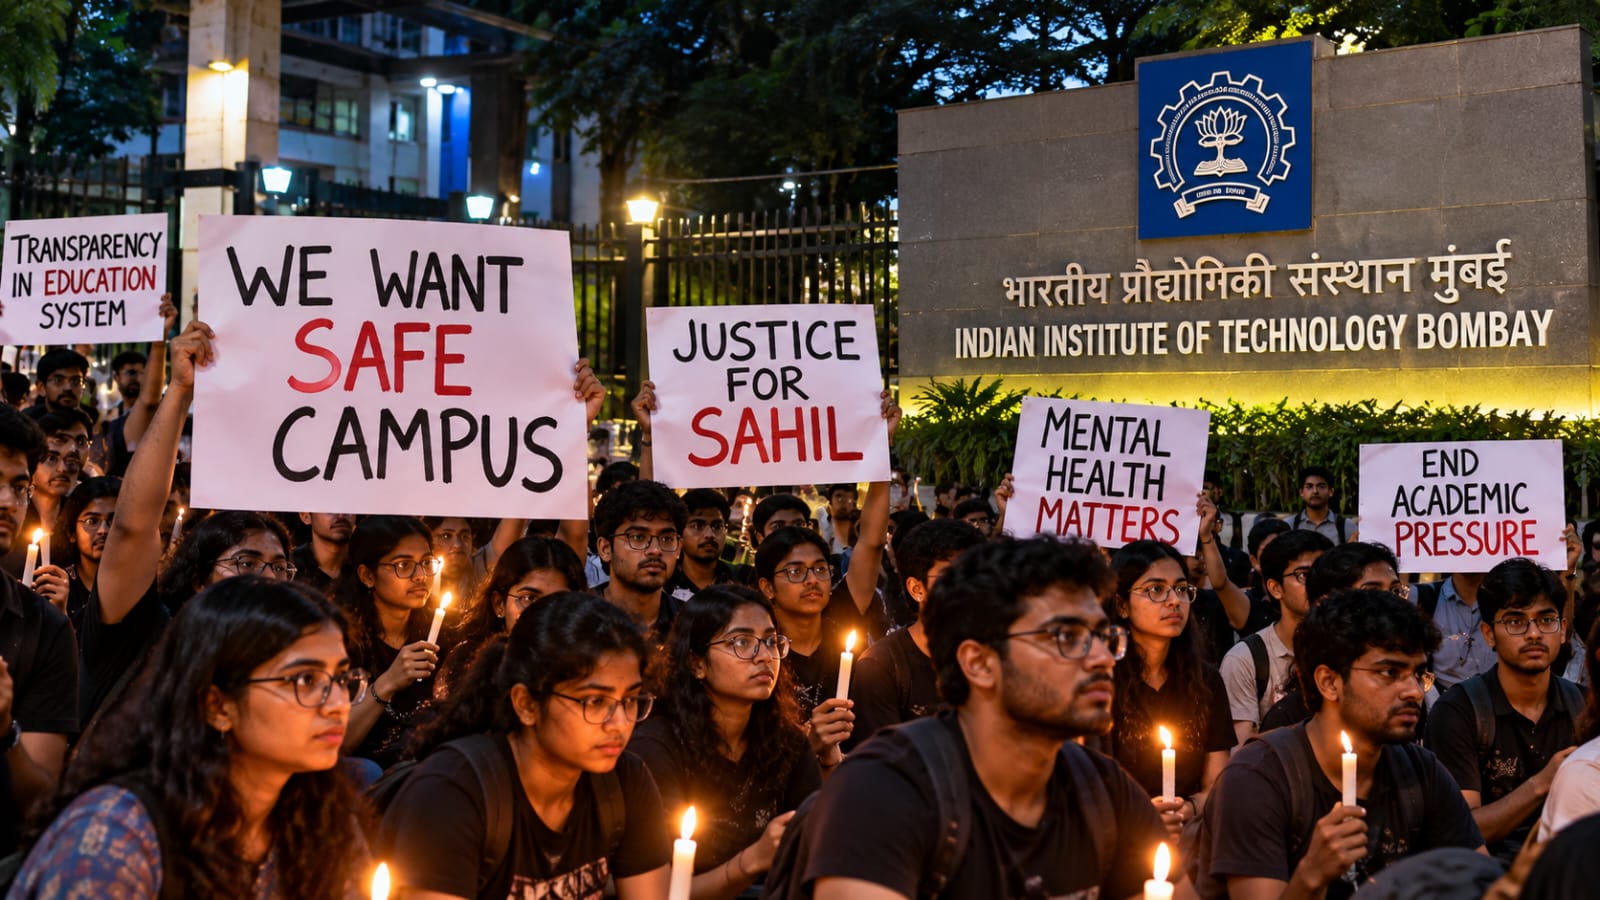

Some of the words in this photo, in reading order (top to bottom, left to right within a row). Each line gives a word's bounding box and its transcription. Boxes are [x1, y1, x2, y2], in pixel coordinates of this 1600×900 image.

[10, 231, 163, 264] TRANSPARENCY
[12, 271, 32, 298] IN
[44, 265, 157, 296] EDUCATION
[226, 245, 334, 307] WE
[370, 248, 525, 314] WANT
[1002, 262, 1112, 308] भारतीय
[1119, 252, 1277, 303] प्रौद्योगिकी
[1287, 251, 1417, 296] संस्थान
[1427, 238, 1512, 304] मुंबई
[39, 299, 126, 329] SYSTEM
[955, 325, 1035, 359] INDIAN
[1043, 321, 1168, 358] INSTITUTE
[1176, 320, 1211, 354] OF
[1218, 313, 1408, 354] TECHNOLOGY
[1416, 308, 1554, 350] BOMBAY
[287, 318, 473, 397] SAFE
[672, 318, 861, 363] JUSTICE
[726, 365, 810, 402] FOR
[272, 405, 564, 493] CAMPUS
[687, 406, 864, 467] SAHIL
[1040, 406, 1171, 458] MENTAL
[1045, 455, 1166, 502] HEALTH
[1422, 448, 1479, 478] END
[1035, 496, 1180, 546] MATTERS
[1390, 482, 1530, 518] ACADEMIC
[1395, 519, 1540, 557] PRESSURE
